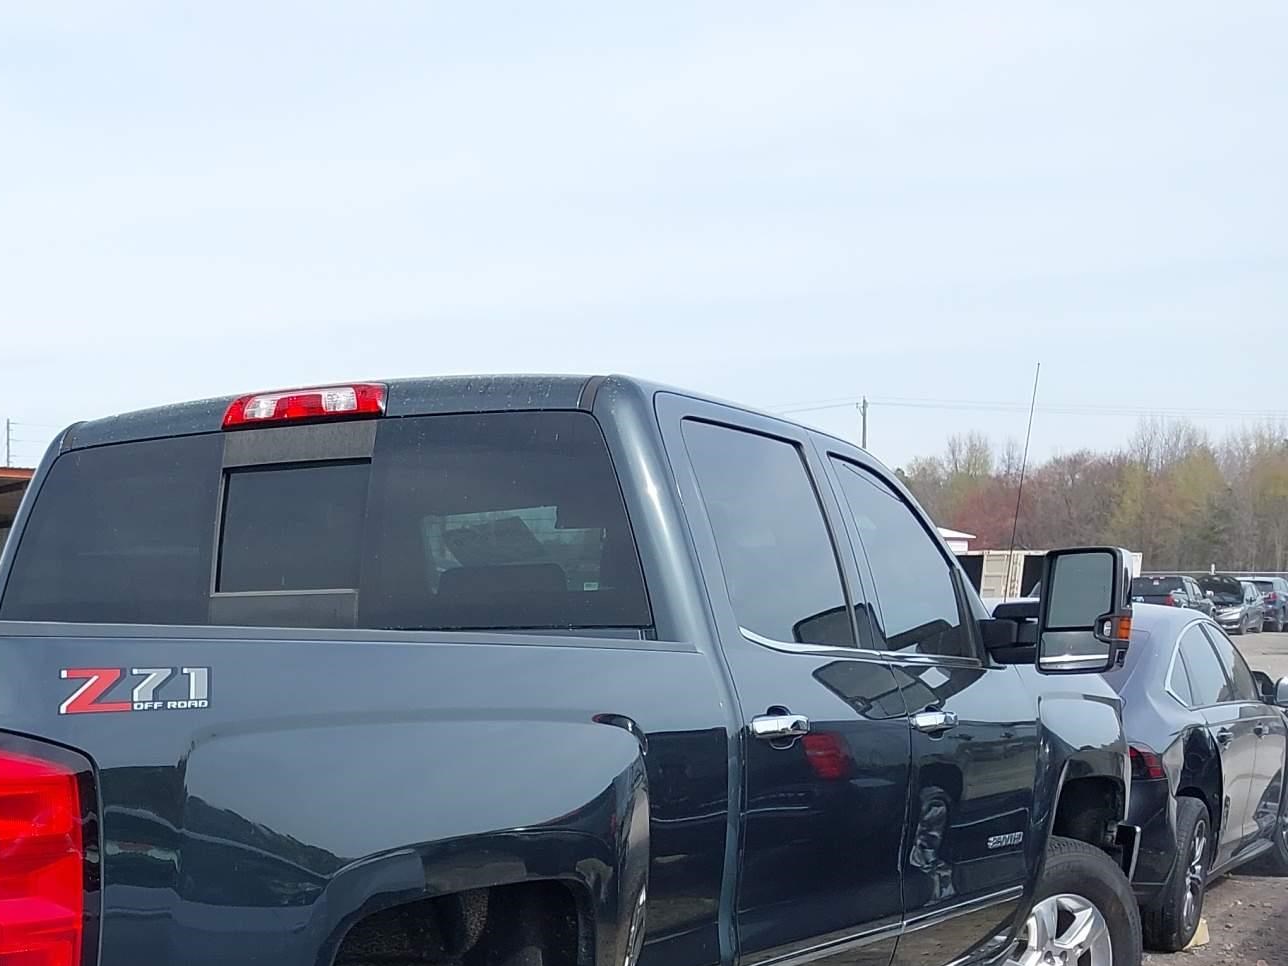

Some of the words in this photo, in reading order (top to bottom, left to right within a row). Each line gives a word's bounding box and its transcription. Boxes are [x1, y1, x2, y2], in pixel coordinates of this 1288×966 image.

[59, 667, 210, 714] Z71
[133, 701, 163, 711] OFF
[167, 700, 209, 709] ROAD
